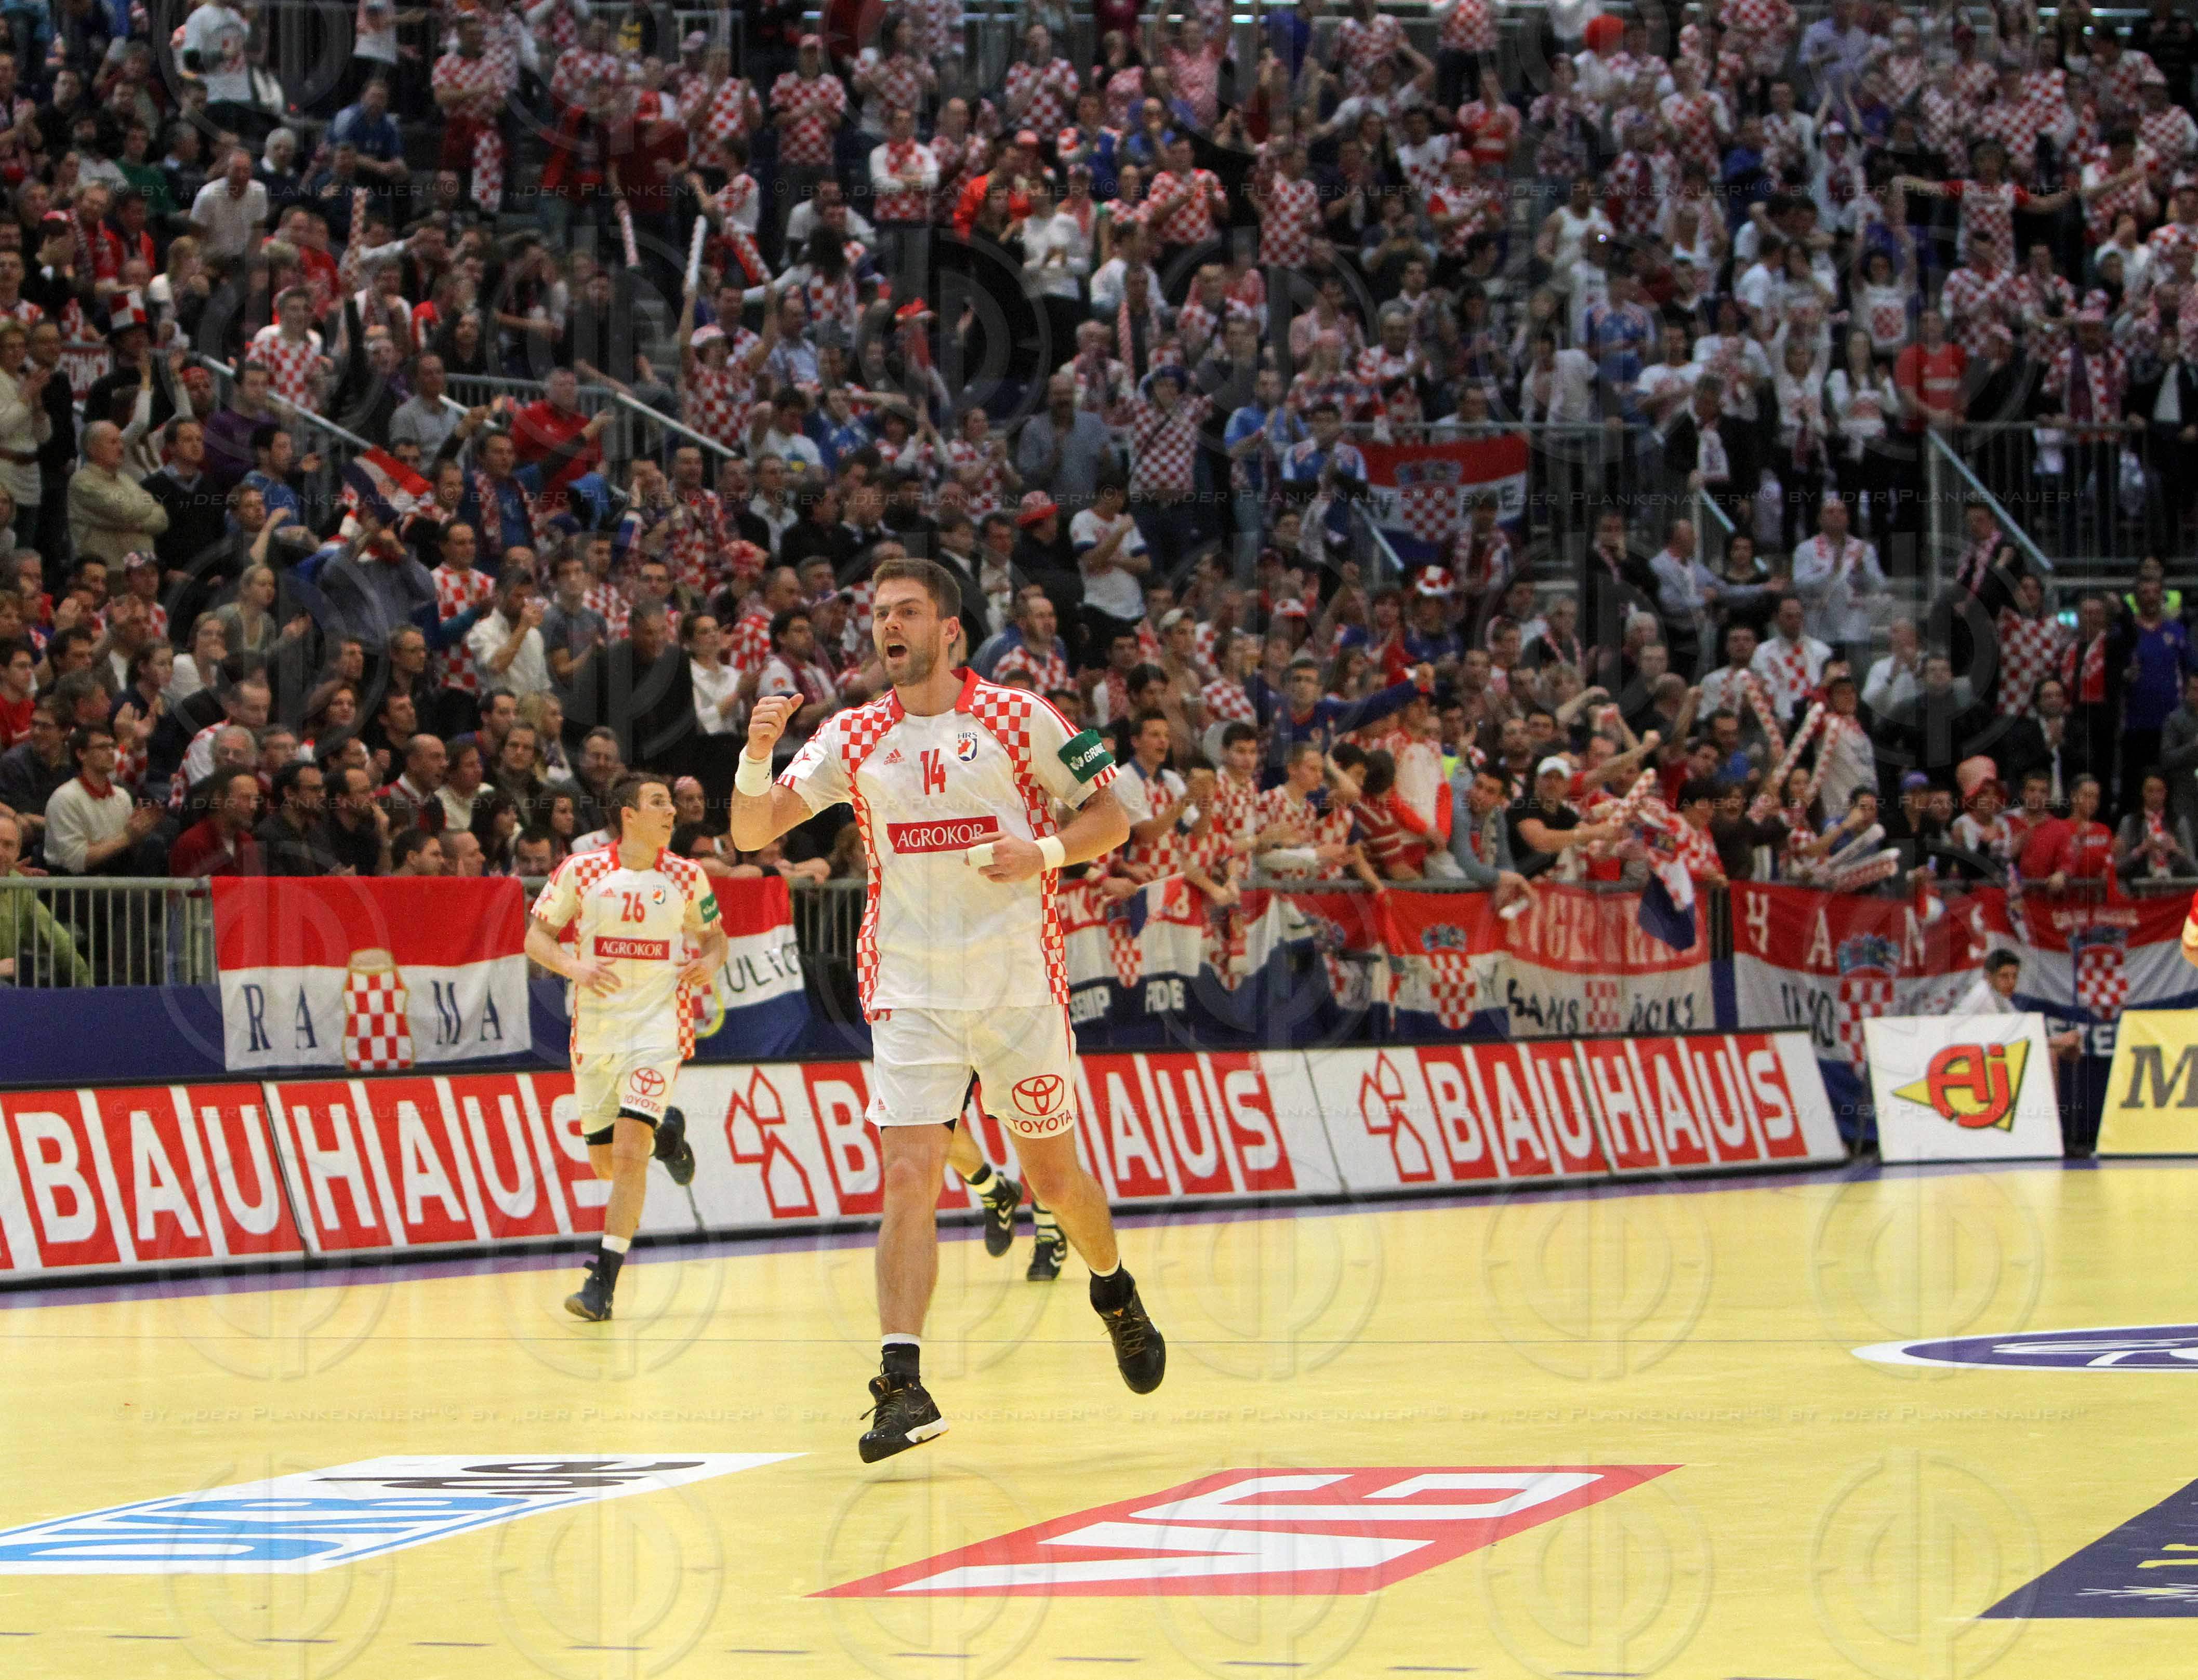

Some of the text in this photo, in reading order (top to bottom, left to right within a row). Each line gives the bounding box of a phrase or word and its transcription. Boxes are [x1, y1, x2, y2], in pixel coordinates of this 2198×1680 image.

[920, 748, 946, 795] 14
[897, 824, 984, 848] AGROKOR
[621, 891, 645, 923] 26
[601, 941, 663, 956] AGROKOR
[1424, 1049, 1795, 1163] BAUHAUS
[1010, 1109, 1072, 1133] TOYOTA
